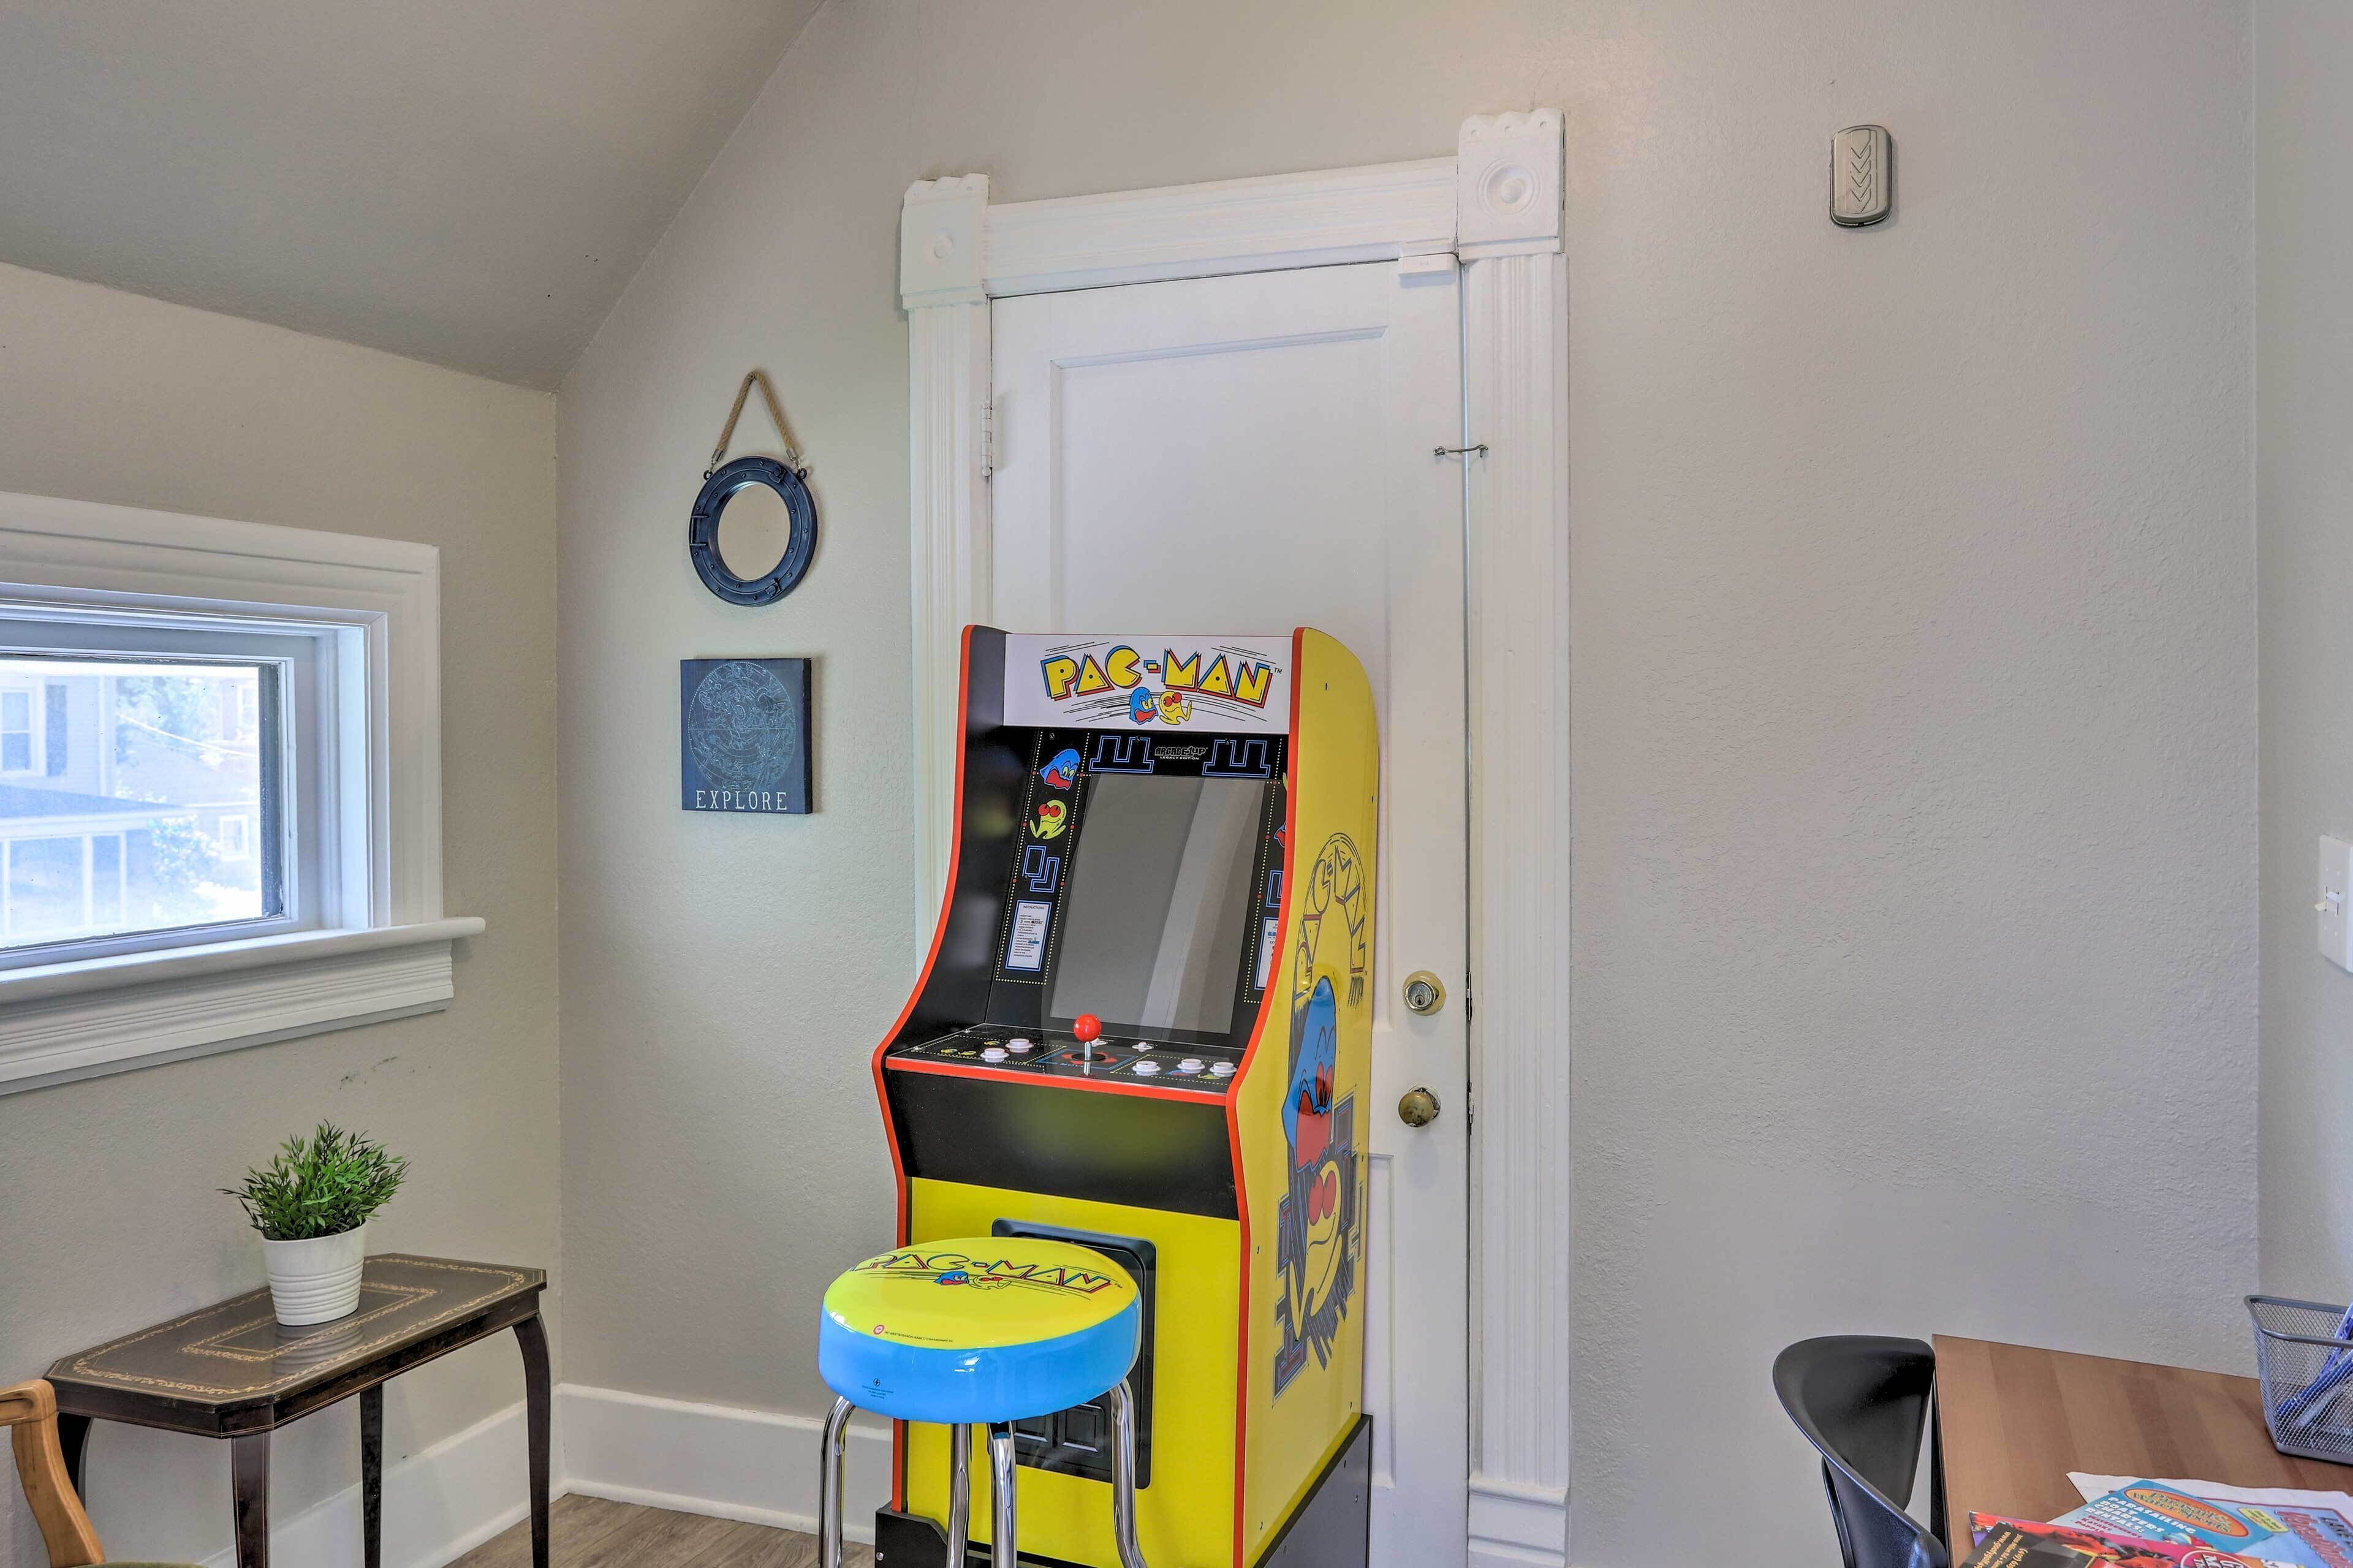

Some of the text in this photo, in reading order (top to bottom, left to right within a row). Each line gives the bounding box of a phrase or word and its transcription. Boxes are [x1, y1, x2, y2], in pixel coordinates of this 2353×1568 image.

[1040, 645, 1273, 708] PAC-MAN
[695, 790, 787, 811] EXPLORE
[849, 1254, 1112, 1293] PAC-MAN
[2094, 1503, 2165, 1532] CHARTERS
[2099, 1500, 2138, 1515] BOAT
[2108, 1497, 2196, 1534] PARASAILING
